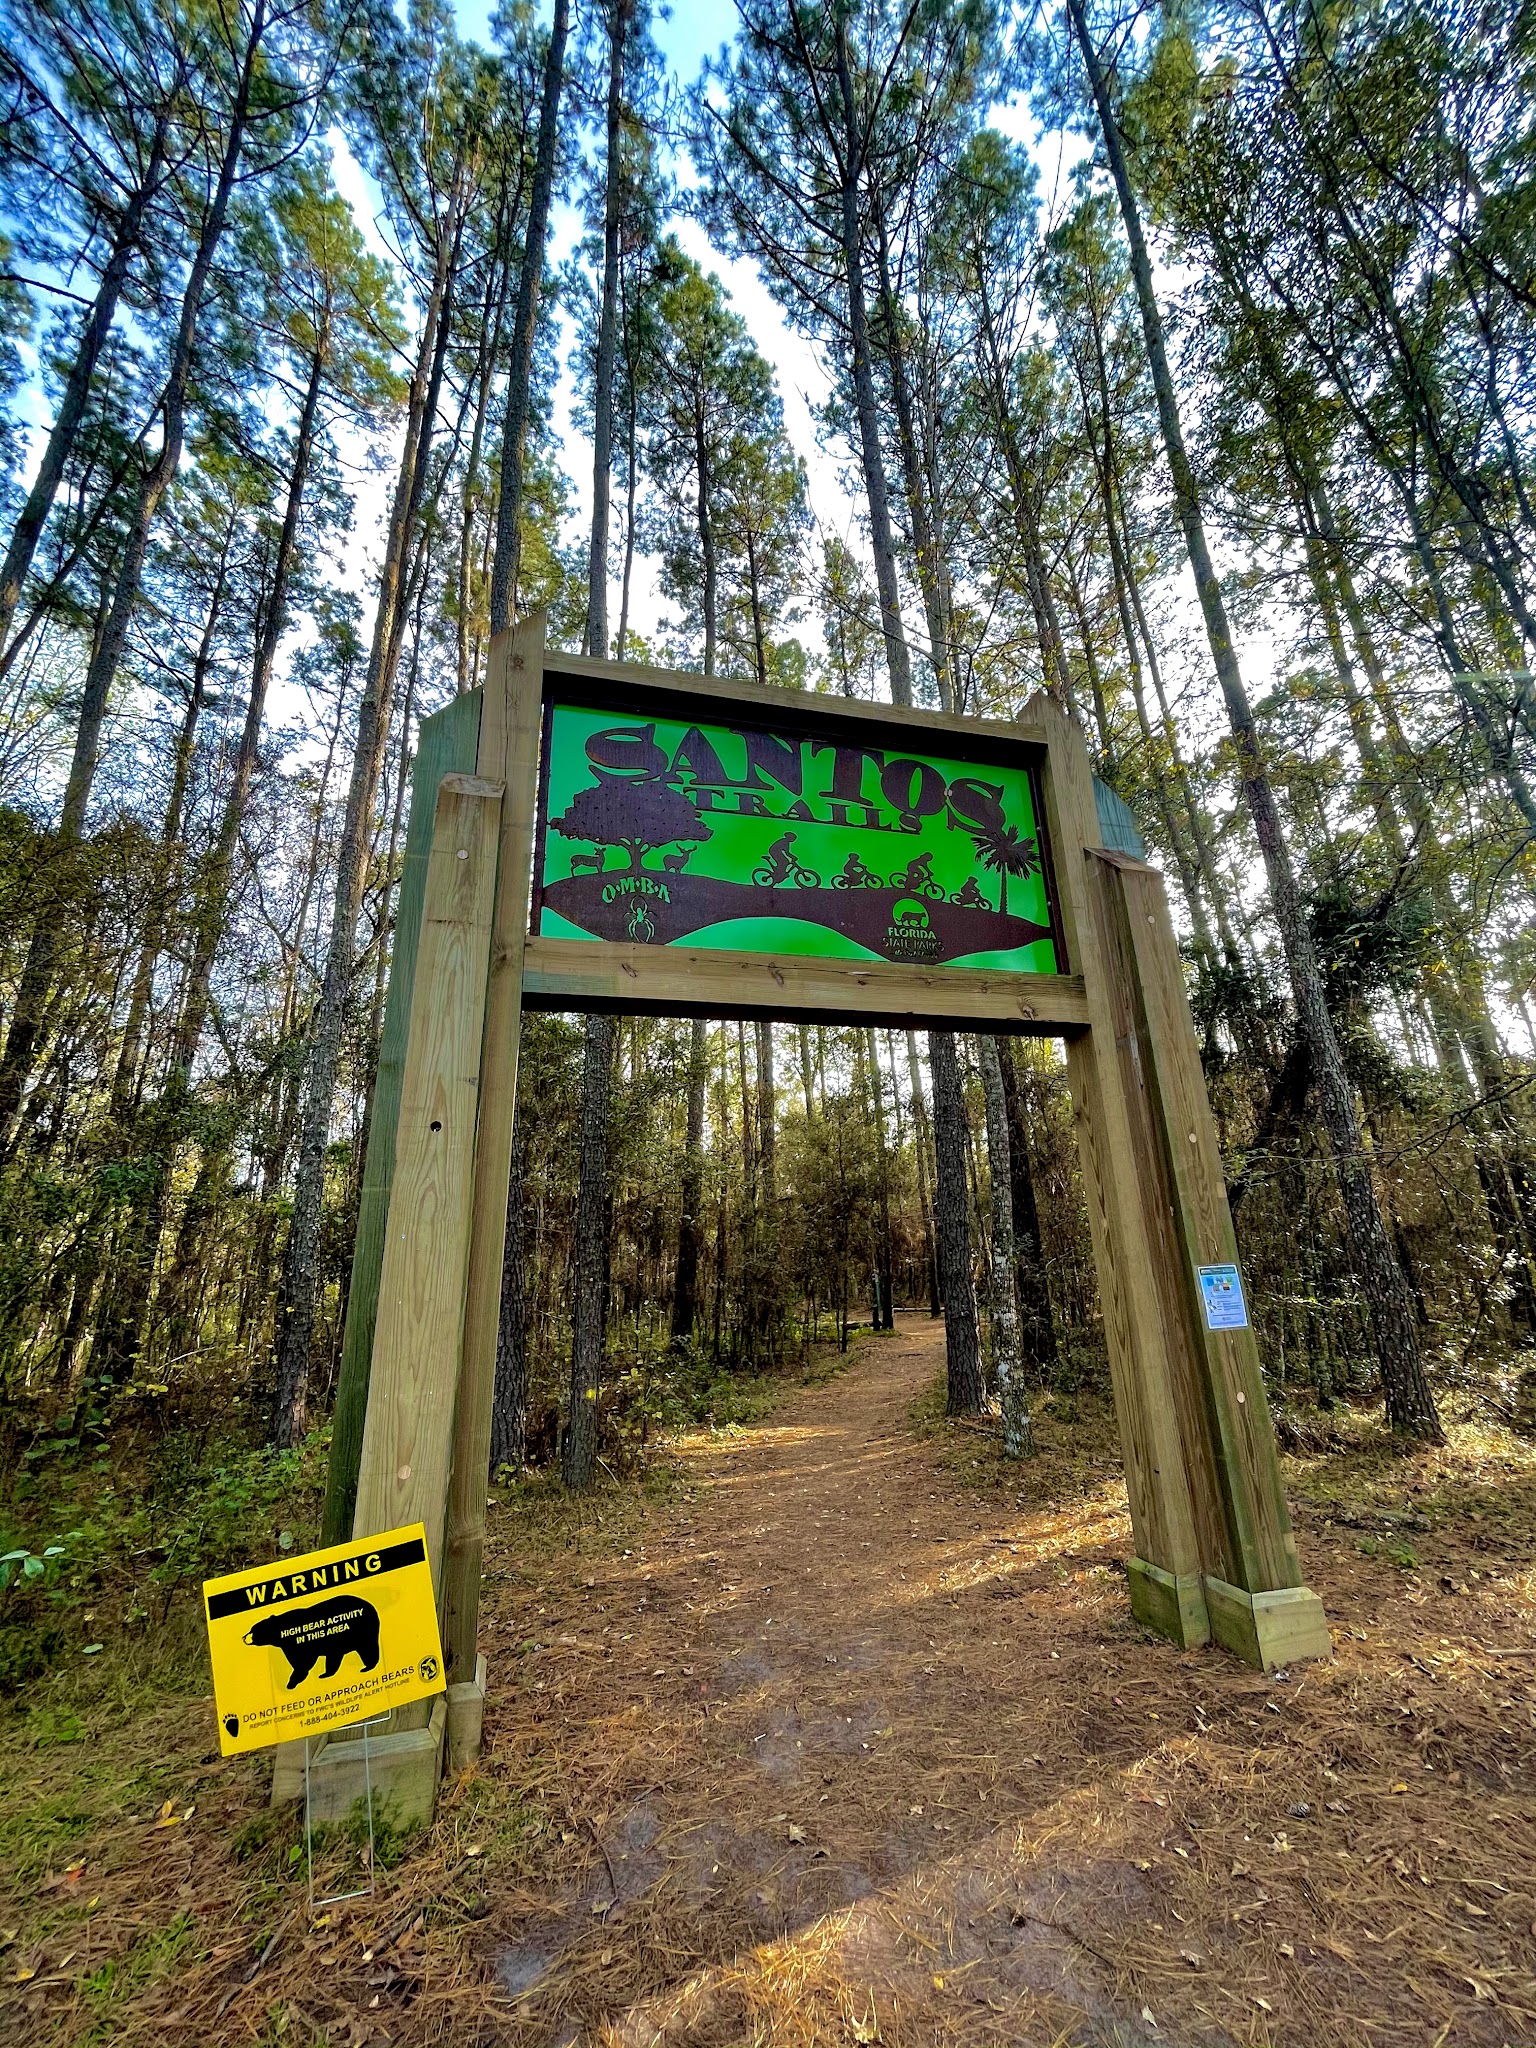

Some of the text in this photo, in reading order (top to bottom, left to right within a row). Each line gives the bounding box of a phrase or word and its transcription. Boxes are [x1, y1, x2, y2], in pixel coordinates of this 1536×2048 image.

[585, 724, 1007, 840] SANTOS
[682, 787, 922, 835] TRAILS
[882, 938, 945, 951] STATE PARKS
[888, 927, 937, 939] FLORIDA
[246, 1554, 382, 1605] WARNING
[281, 1608, 363, 1639] HIGH BEAR ACTIVITY
[296, 1623, 350, 1644] IN THIS AREA
[243, 1666, 415, 1723] DO NOT FEED OR APPROACH BEARS
[249, 1719, 272, 1729] REPORT
[274, 1712, 305, 1723] CONCERNS
[307, 1709, 314, 1717] TO
[336, 1694, 362, 1707] WILDLIFE
[364, 1687, 383, 1698] ALERT
[385, 1677, 410, 1690] HOTLINE
[299, 1704, 360, 1728] 1-888-404-3922
